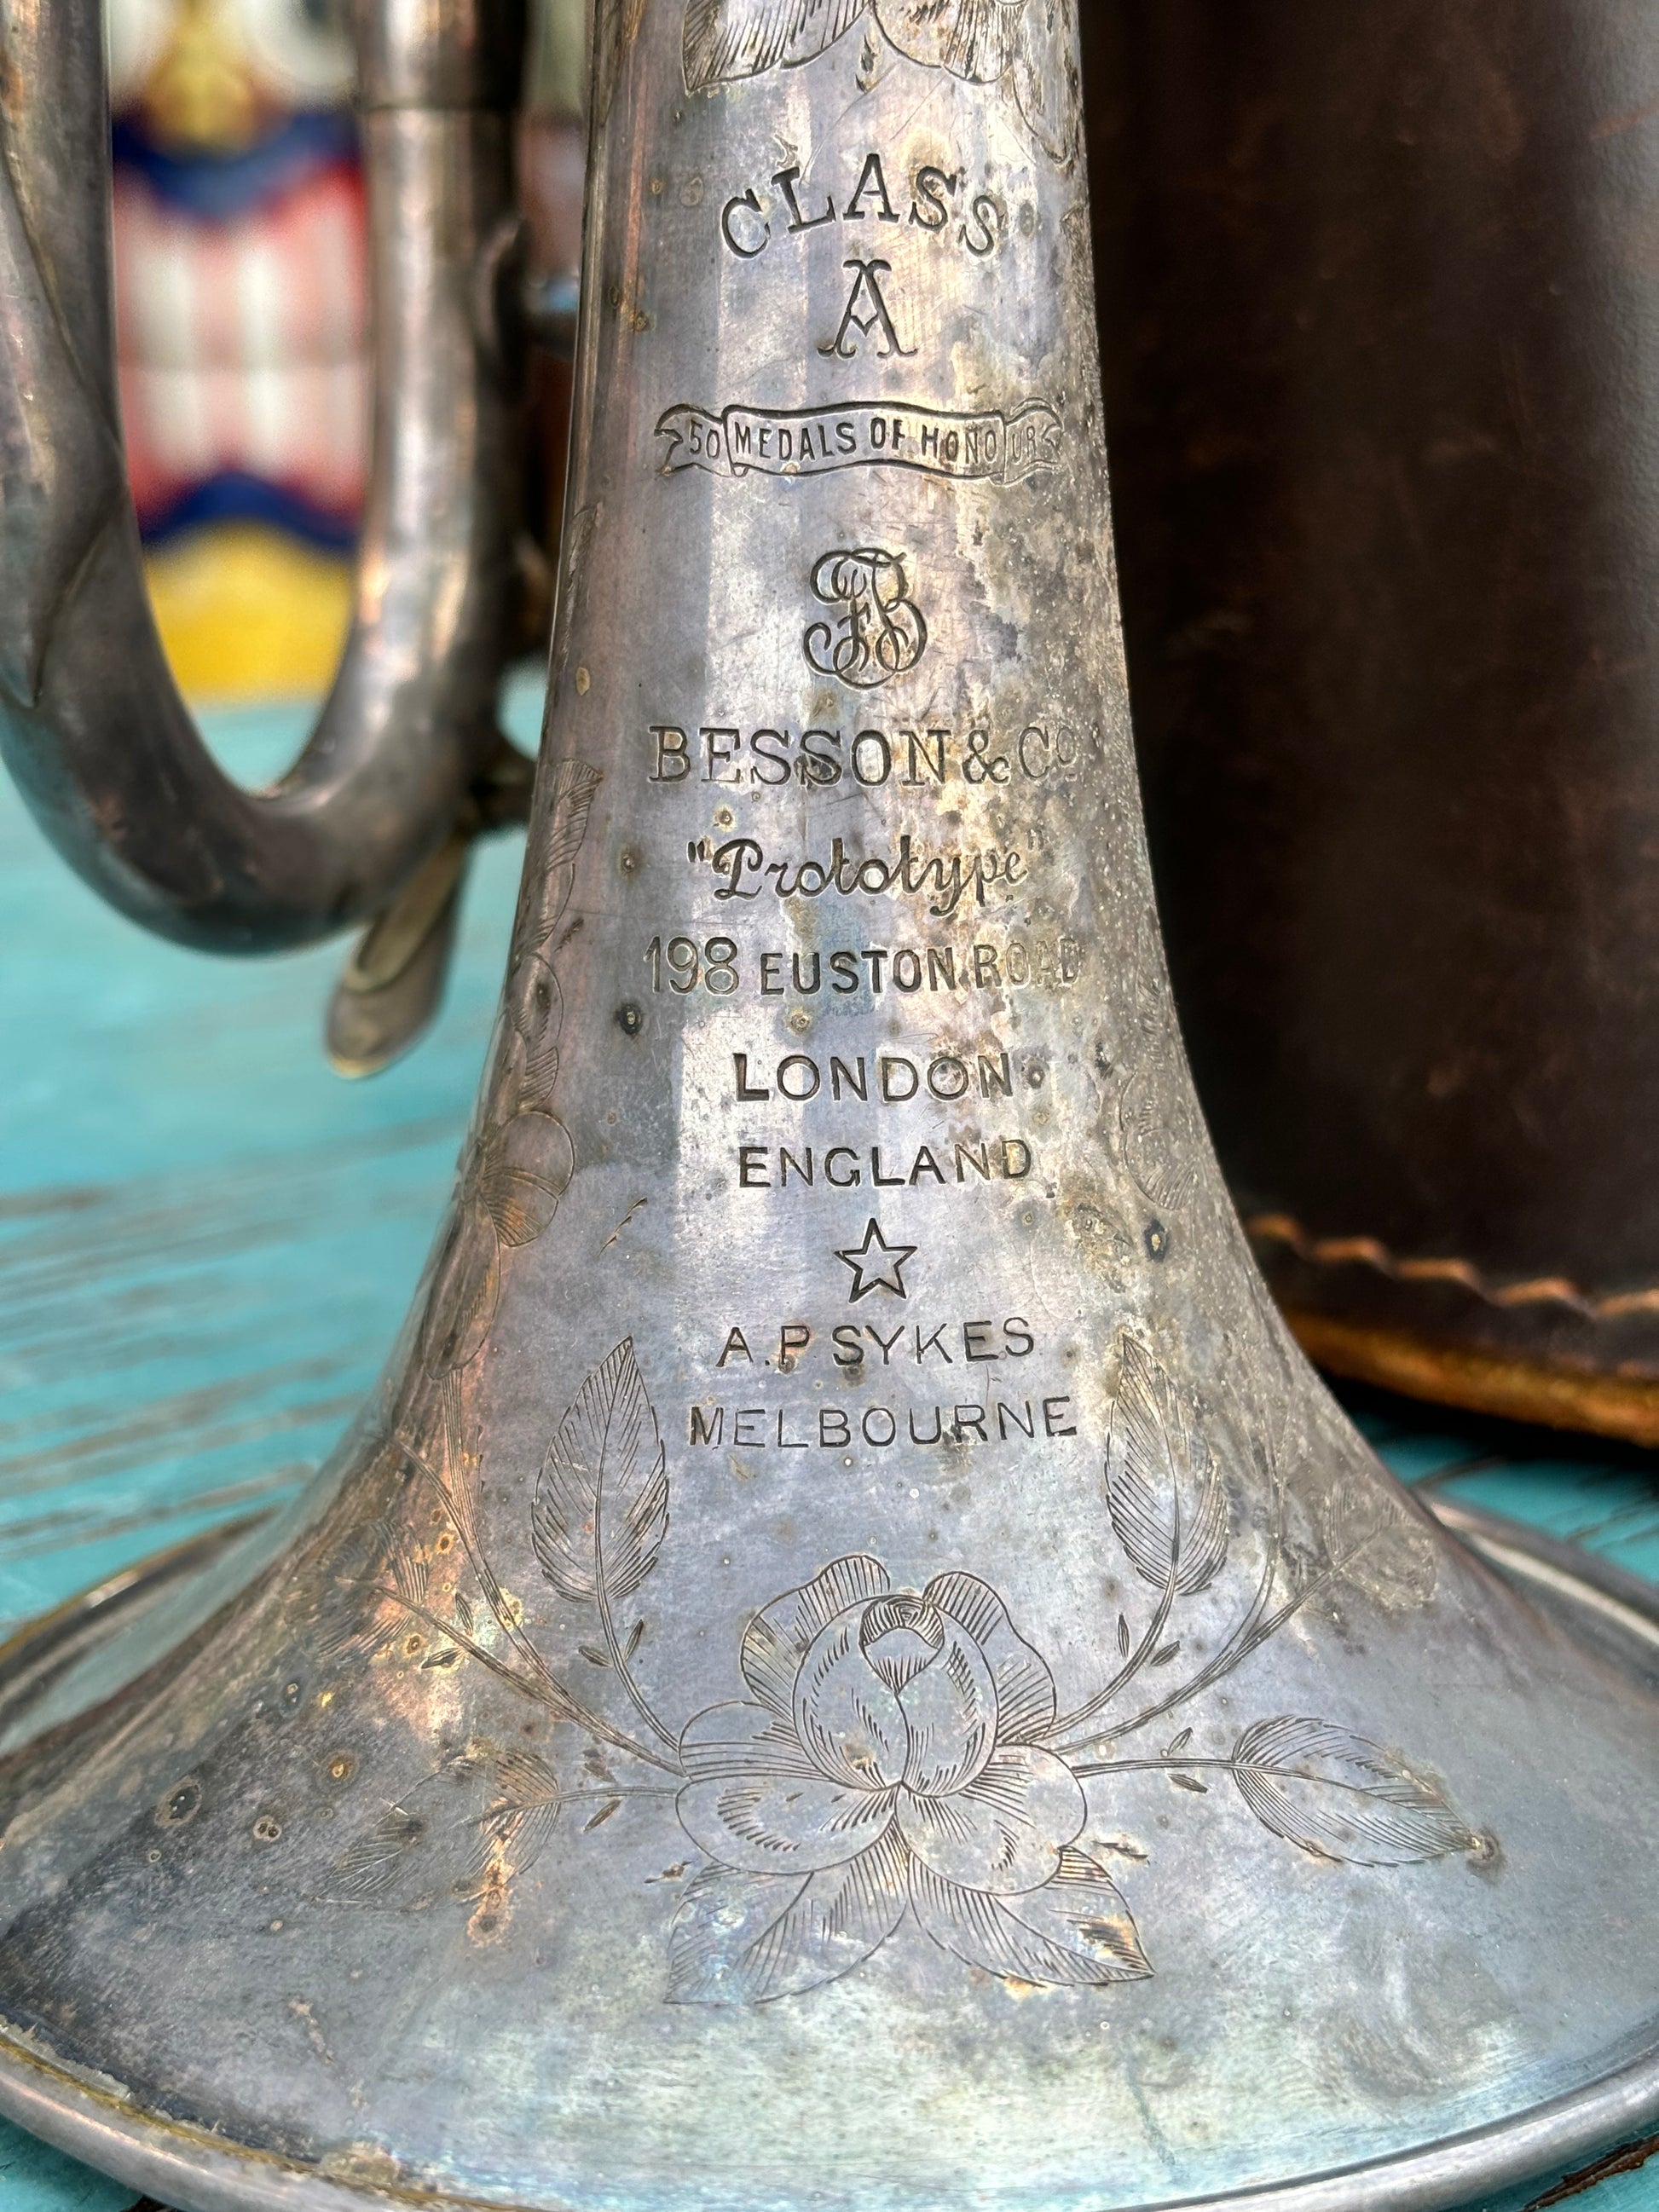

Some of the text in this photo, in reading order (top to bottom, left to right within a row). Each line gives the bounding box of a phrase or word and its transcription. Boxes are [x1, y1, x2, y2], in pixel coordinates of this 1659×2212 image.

[721, 153, 1003, 258] CLASS
[818, 259, 919, 357] A
[690, 416, 1037, 465] 50 MEDALS OF HONOUR
[649, 725, 951, 786] BESSON
[962, 729, 1010, 784] &
[644, 936, 740, 995] 198
[760, 946, 957, 996] EUSTON
[733, 1052, 1014, 1102] LONDON
[738, 1138, 1032, 1188] ENGLAND
[832, 1317, 1035, 1366] SYKES
[690, 1395, 1078, 1448] MELBOURNE
